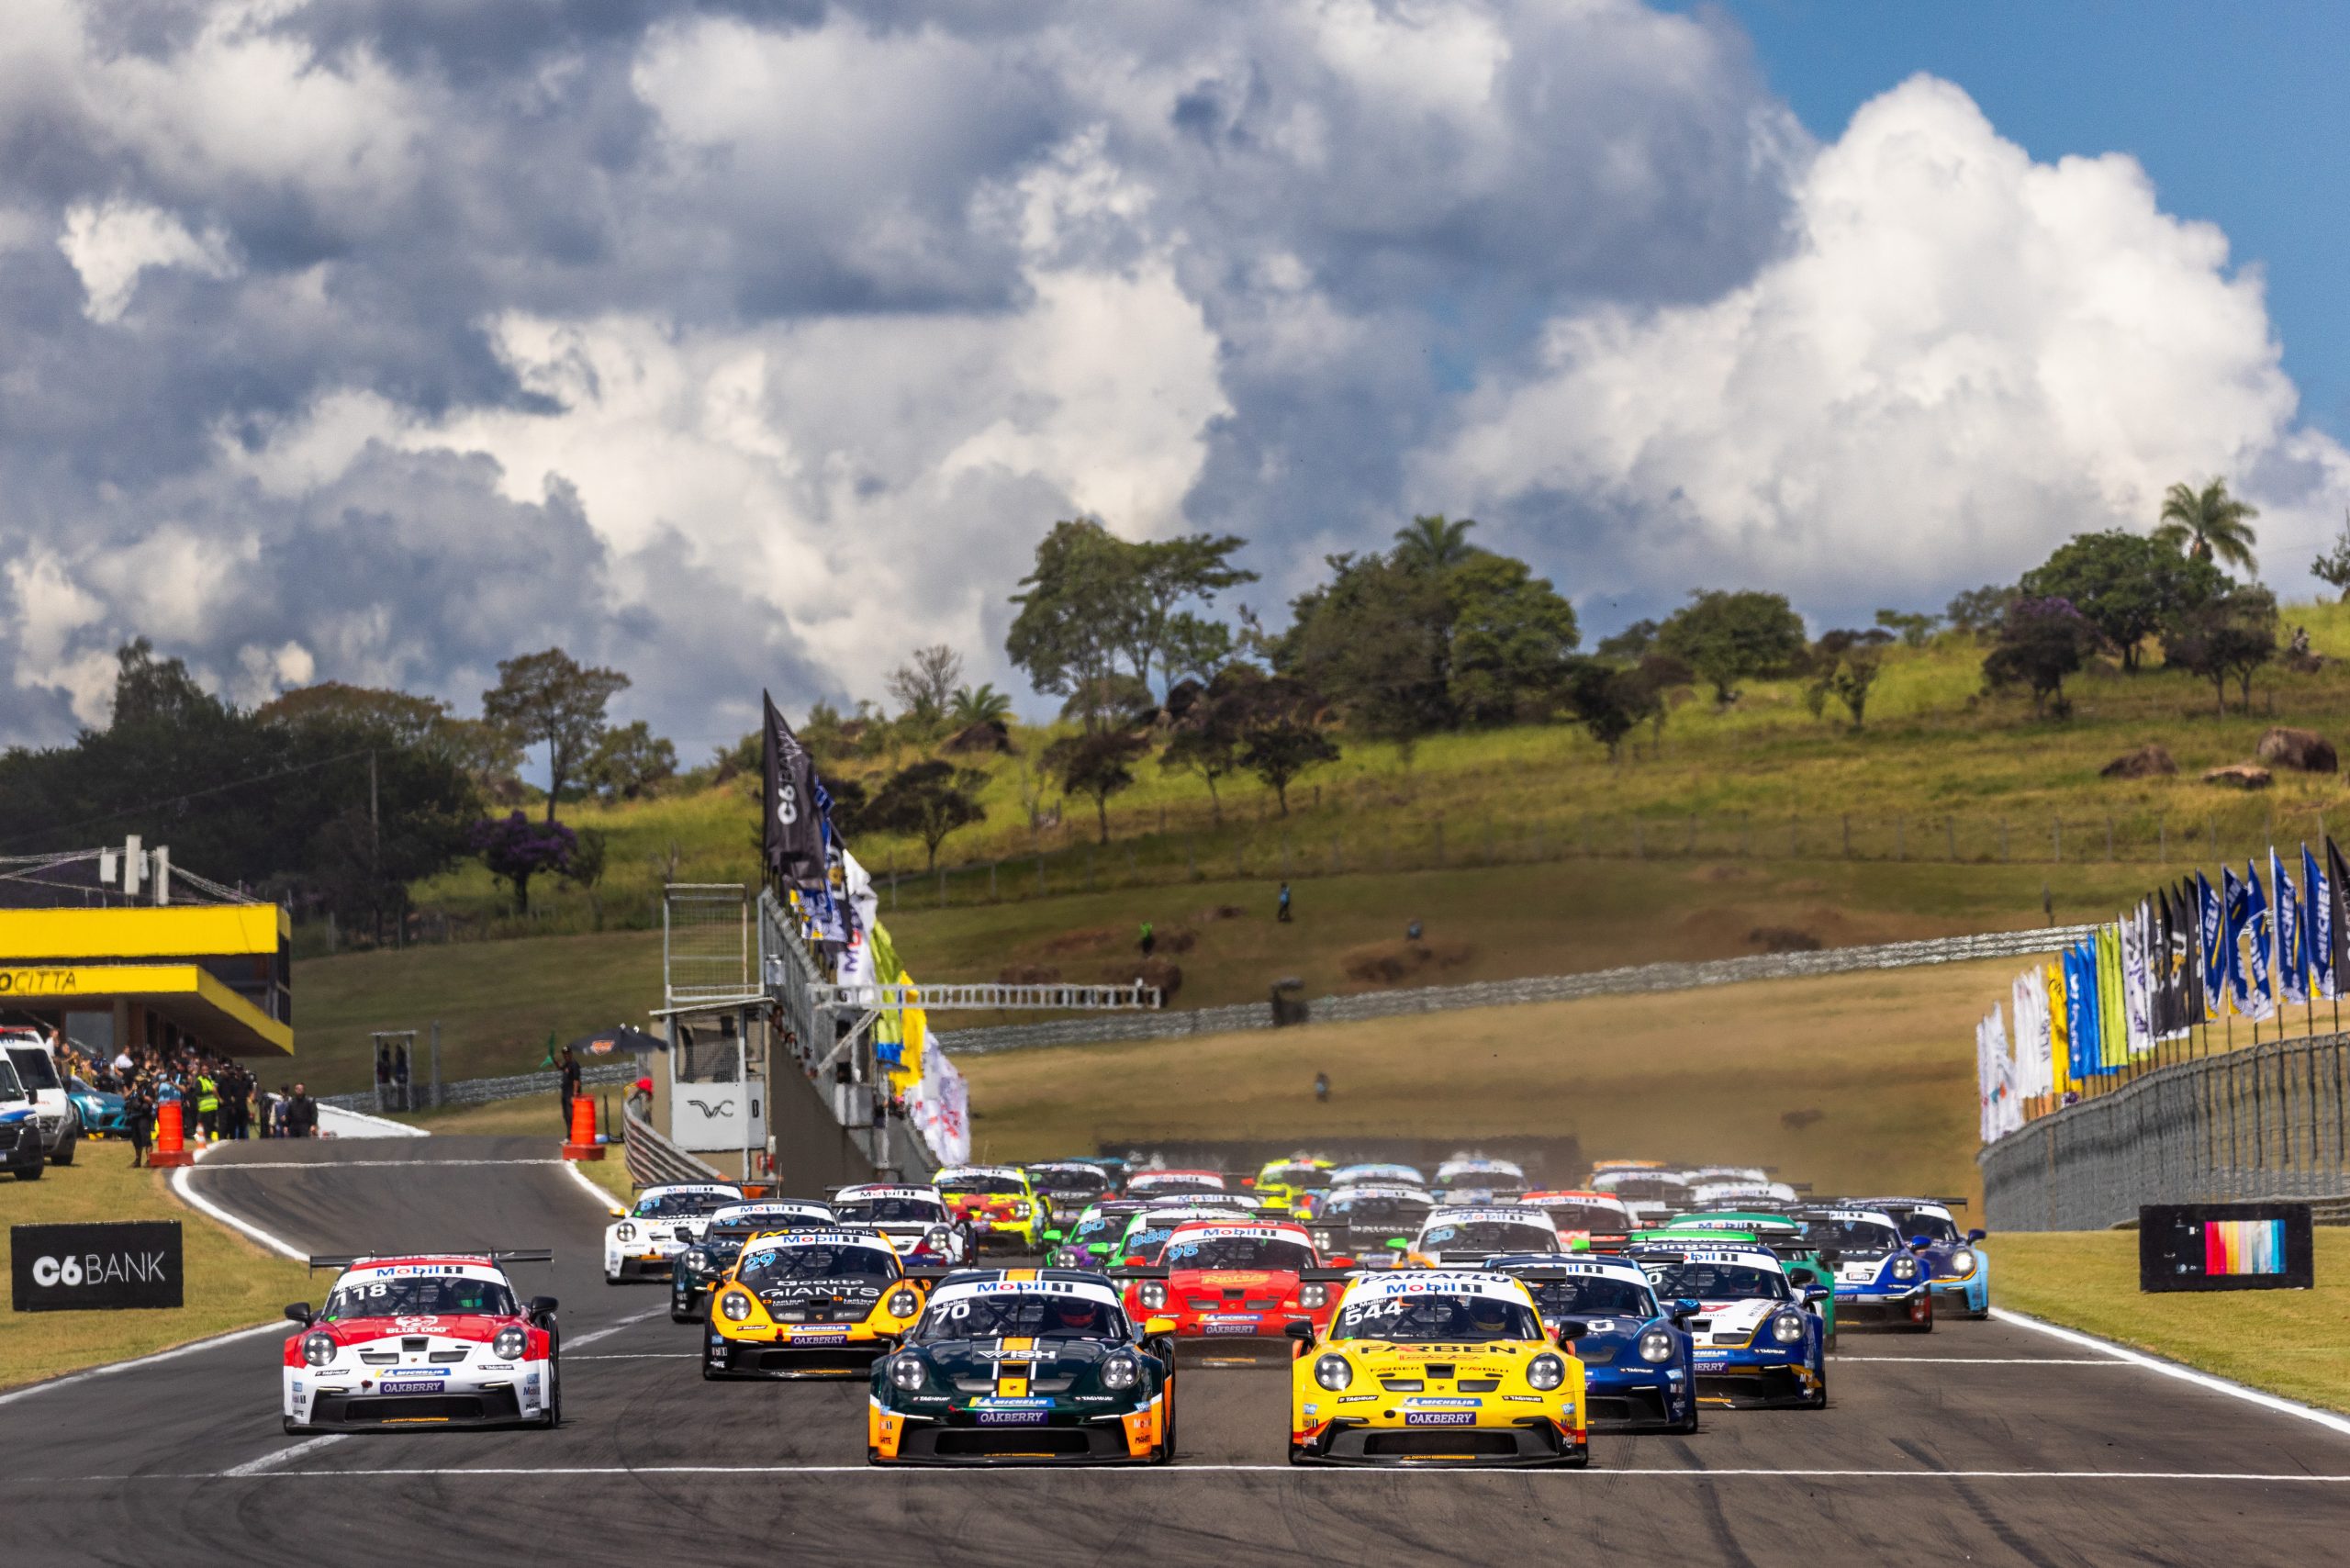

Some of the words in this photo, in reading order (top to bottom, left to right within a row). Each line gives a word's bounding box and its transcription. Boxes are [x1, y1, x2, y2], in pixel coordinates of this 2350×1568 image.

[740, 1204, 785, 1214] Mobil
[1203, 1227, 1257, 1238] Mobil
[784, 1235, 838, 1244] Mobil
[1644, 1244, 1758, 1252] Kingspan
[744, 1253, 776, 1272] 29
[376, 1265, 439, 1277] Mobil
[1361, 1272, 1512, 1284] PARAFLU
[760, 1286, 880, 1297] GIANTS
[977, 1282, 1046, 1293] Mobil
[1386, 1282, 1456, 1294] Mobil
[336, 1283, 387, 1306] 118
[933, 1305, 970, 1325] 70
[1345, 1300, 1404, 1327] 544
[1205, 1325, 1255, 1335] OAKBERRY
[793, 1336, 845, 1345] OAKBERRY
[978, 1350, 1057, 1359] WISH
[1361, 1346, 1516, 1354] FARBEN
[384, 1382, 442, 1393] OAKBERRY
[980, 1412, 1044, 1423] OAKBERRY
[1408, 1412, 1472, 1424] OAKBERRY
